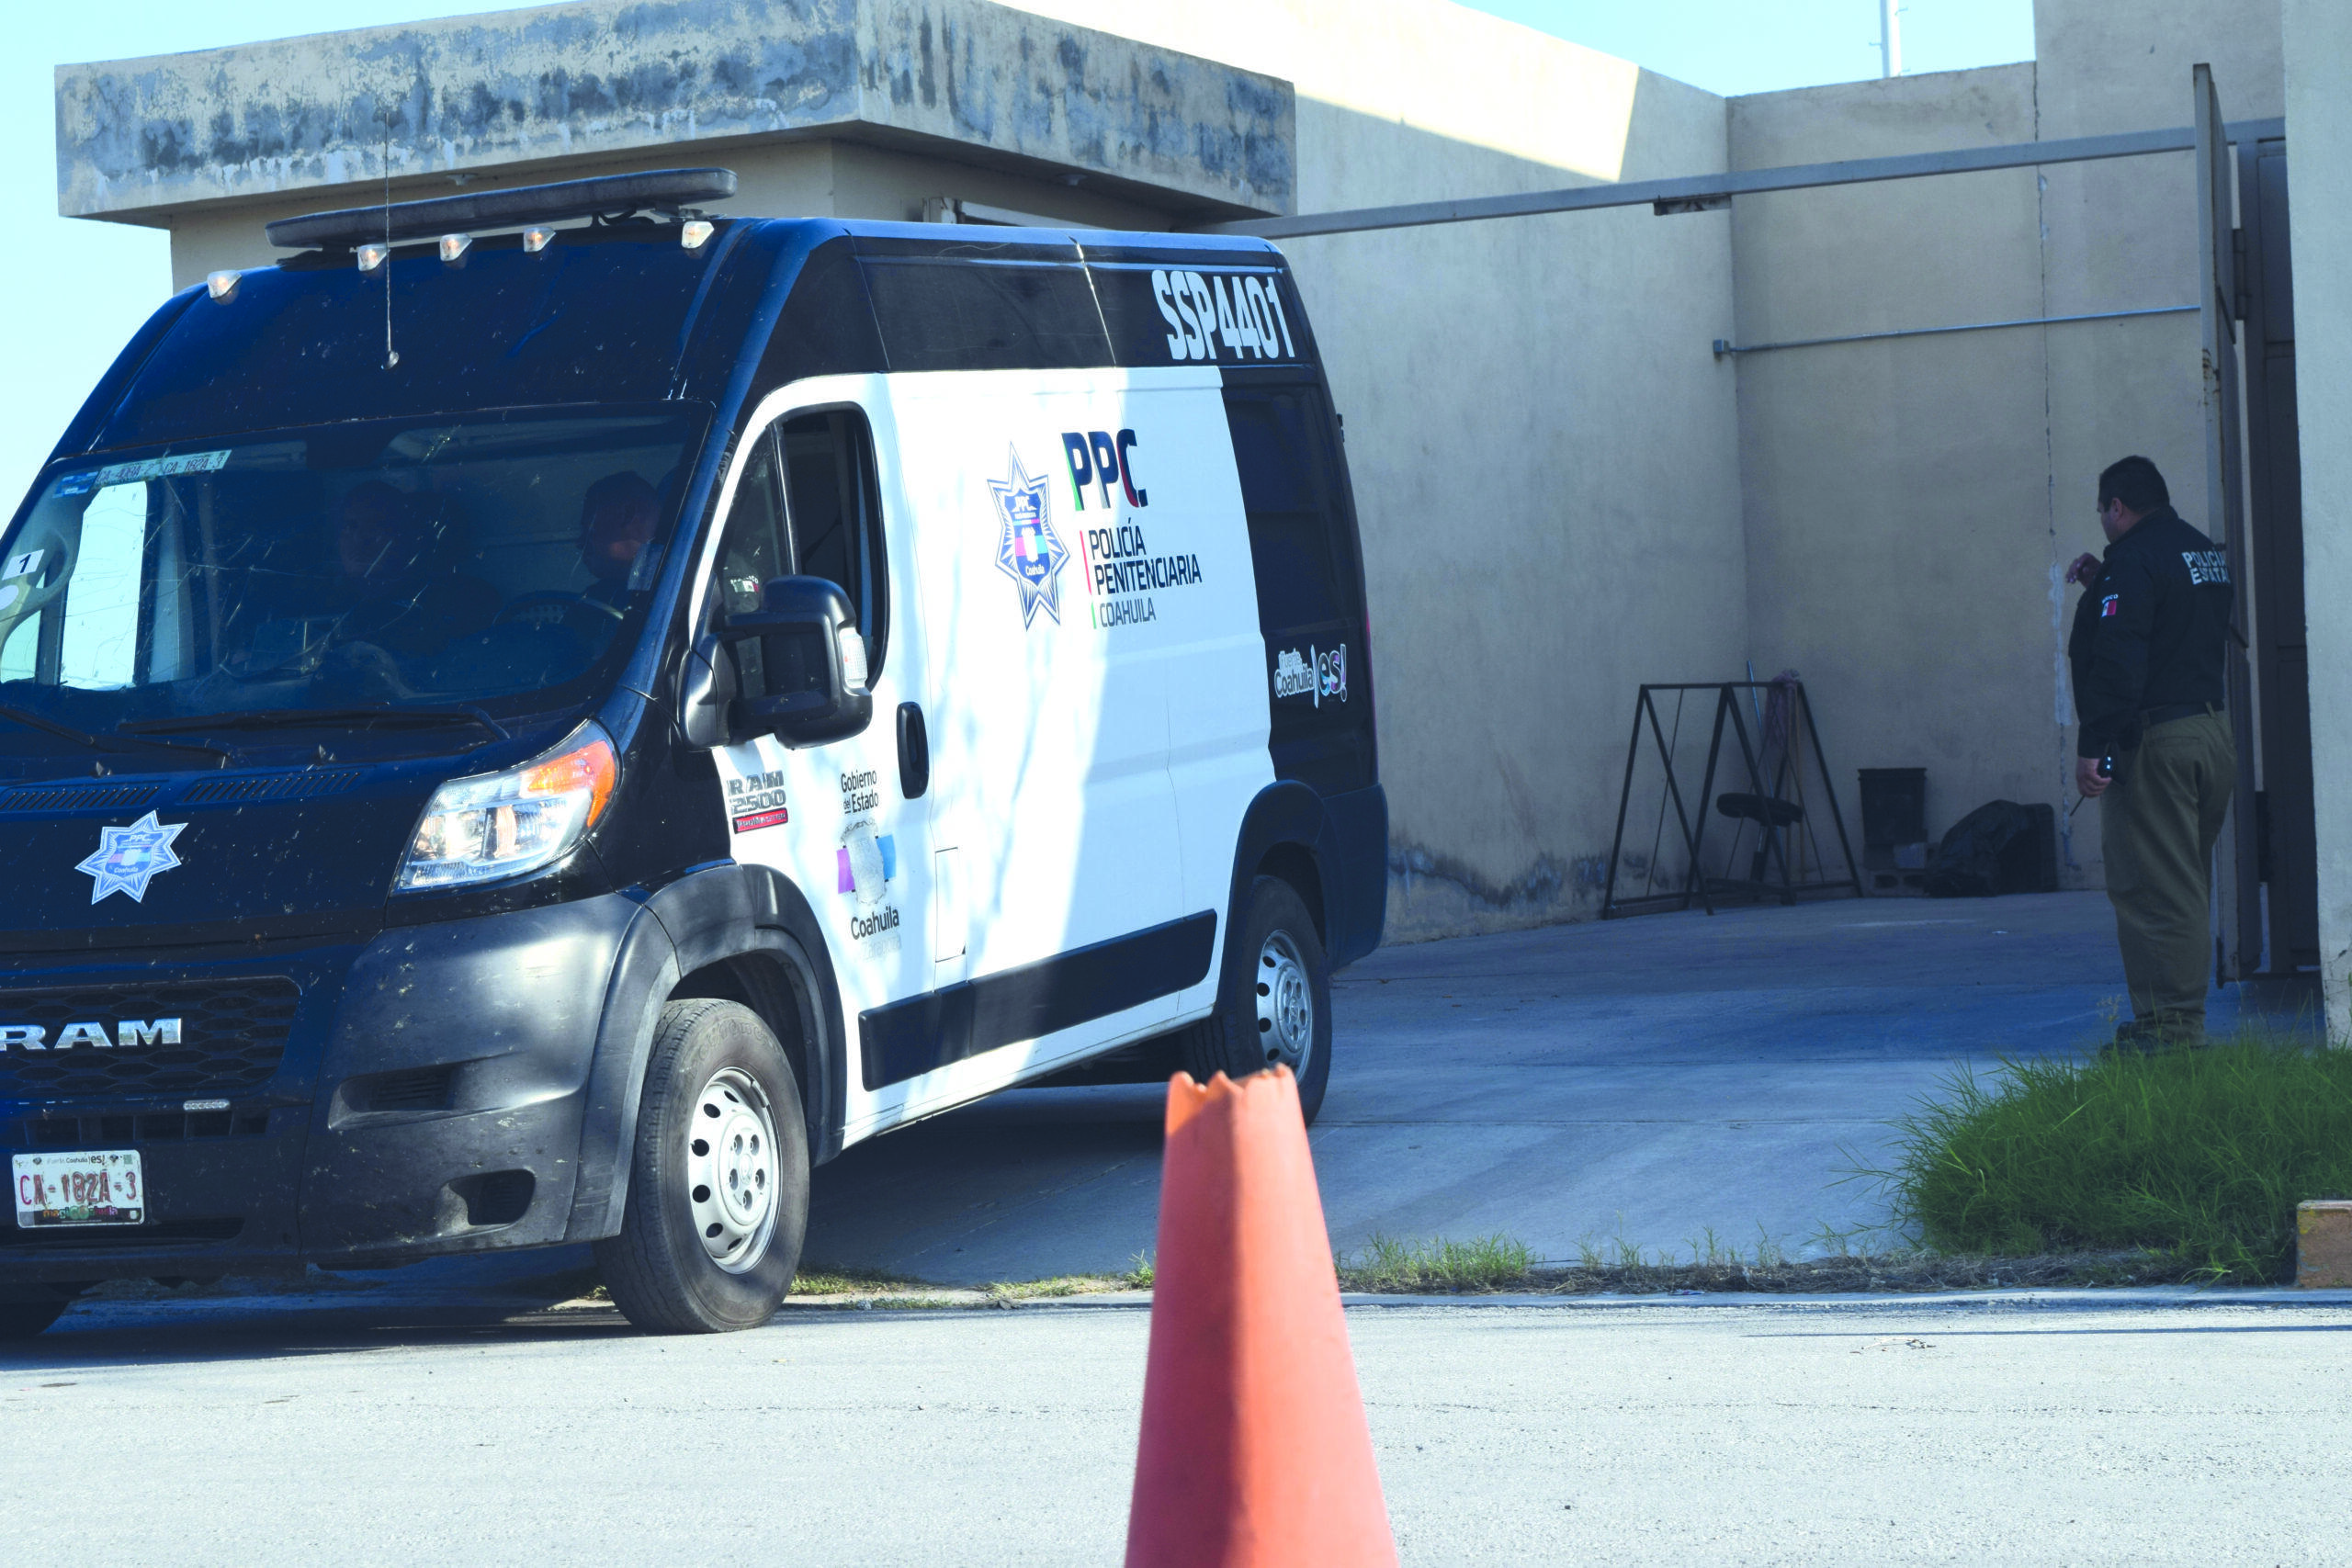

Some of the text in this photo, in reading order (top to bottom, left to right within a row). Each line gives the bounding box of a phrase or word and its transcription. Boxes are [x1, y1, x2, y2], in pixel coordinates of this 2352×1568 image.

[1151, 270, 1295, 360] SSP4401
[1061, 429, 1148, 512] PPC
[1088, 516, 1147, 560] POLICÍA
[19, 554, 31, 573] 1
[1094, 553, 1203, 595] PENITENCIARIA
[1100, 597, 1157, 627] COAHUILA
[1274, 663, 1314, 698] Coahuila
[727, 770, 785, 796] RAM
[841, 769, 877, 793] Gobierno
[729, 789, 786, 815] 2500
[851, 789, 879, 813] Estado
[851, 906, 900, 940] Coahuila
[0, 1018, 181, 1051] RAM
